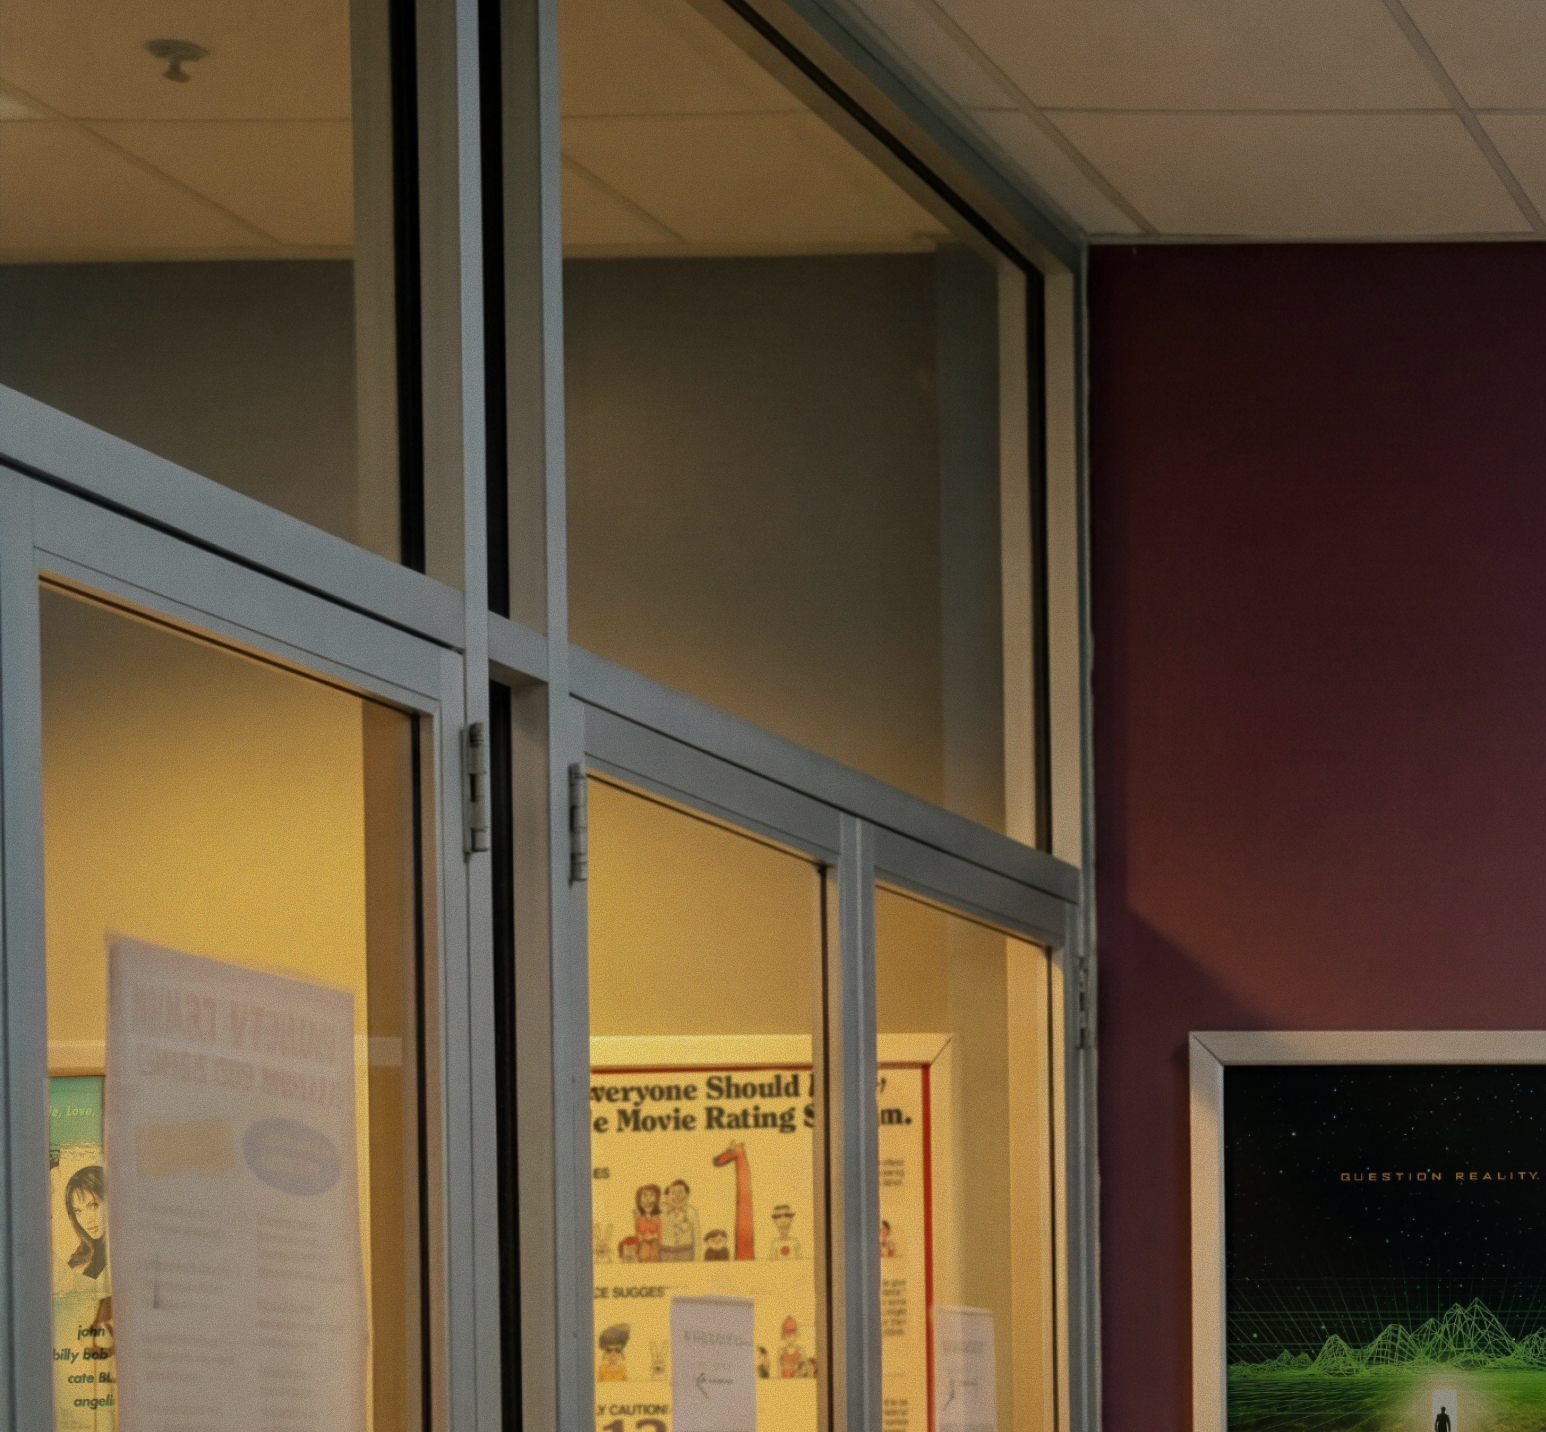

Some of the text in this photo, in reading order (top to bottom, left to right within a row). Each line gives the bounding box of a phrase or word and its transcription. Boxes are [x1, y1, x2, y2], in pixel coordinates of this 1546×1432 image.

[590, 1082, 698, 1106] veryone
[706, 1074, 800, 1100] Should
[67, 1106, 96, 1119] Love,
[617, 1108, 697, 1132] Movie
[704, 1106, 797, 1133] Rating
[1340, 1171, 1540, 1182] QUESTION REALITY.
[612, 1287, 670, 1298] SUGGES
[77, 1325, 106, 1340] john
[53, 1347, 109, 1364] billy bob
[68, 1374, 95, 1384] cate
[74, 1394, 115, 1409] angeli
[609, 1404, 669, 1415] CAUTION
